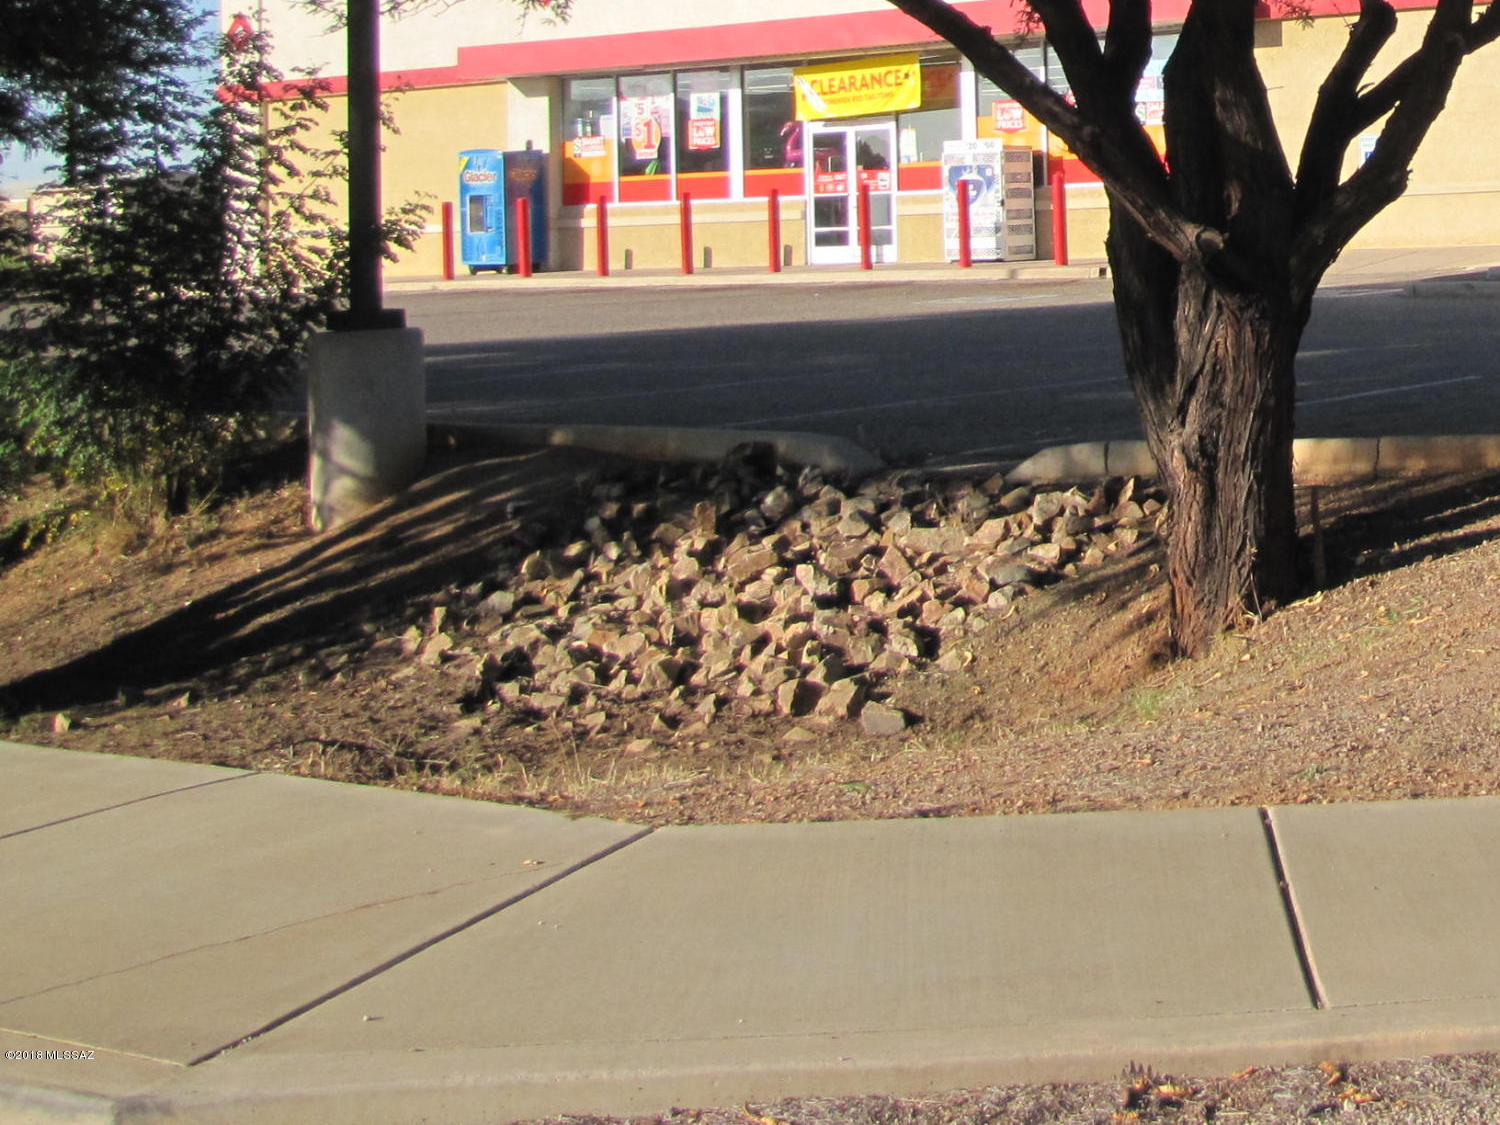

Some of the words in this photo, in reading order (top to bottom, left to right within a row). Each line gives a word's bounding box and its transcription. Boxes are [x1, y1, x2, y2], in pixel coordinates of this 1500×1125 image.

[810, 69, 904, 96] CLEARANCE
[634, 119, 656, 150] $1
[463, 170, 497, 183] Glacier
